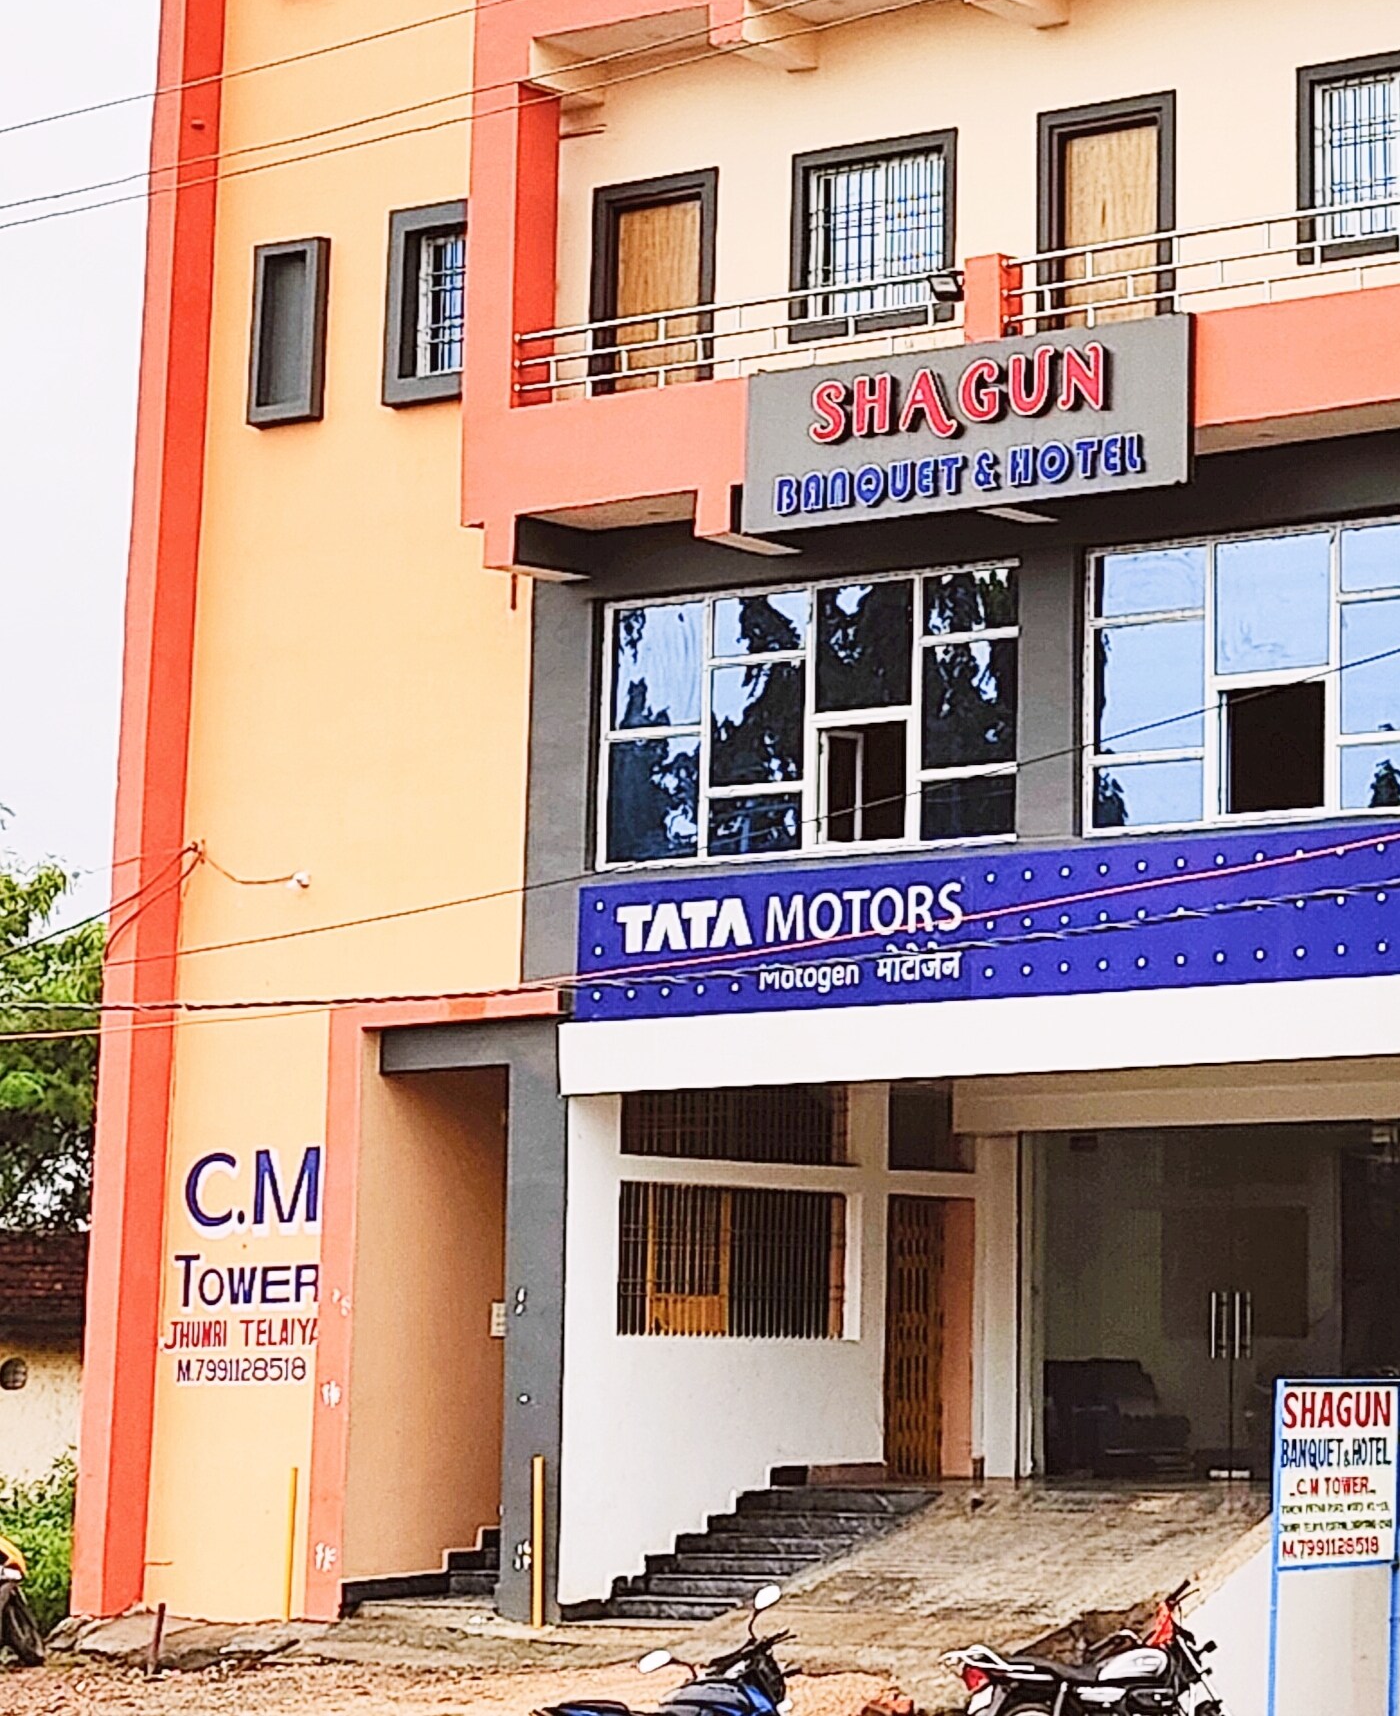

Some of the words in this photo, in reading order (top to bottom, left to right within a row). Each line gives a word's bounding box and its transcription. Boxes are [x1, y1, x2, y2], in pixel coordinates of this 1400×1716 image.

[808, 341, 1106, 444] SHAGUN
[774, 453, 964, 515] BANQUET
[972, 449, 999, 490] &
[1009, 432, 1144, 486] HOTEL
[616, 897, 754, 955] TATA
[765, 882, 964, 945] MOTORS
[758, 963, 861, 993] Motogen
[185, 1146, 321, 1227] C.M
[174, 1253, 320, 1308] TOWER
[164, 1320, 228, 1350] JHUMRI
[239, 1317, 318, 1347] TELAIYA
[176, 1356, 307, 1383] M.7991128518
[1282, 1390, 1391, 1430] SHAGUN
[1280, 1438, 1343, 1471] BANQUET
[1352, 1437, 1392, 1467] HOTEL
